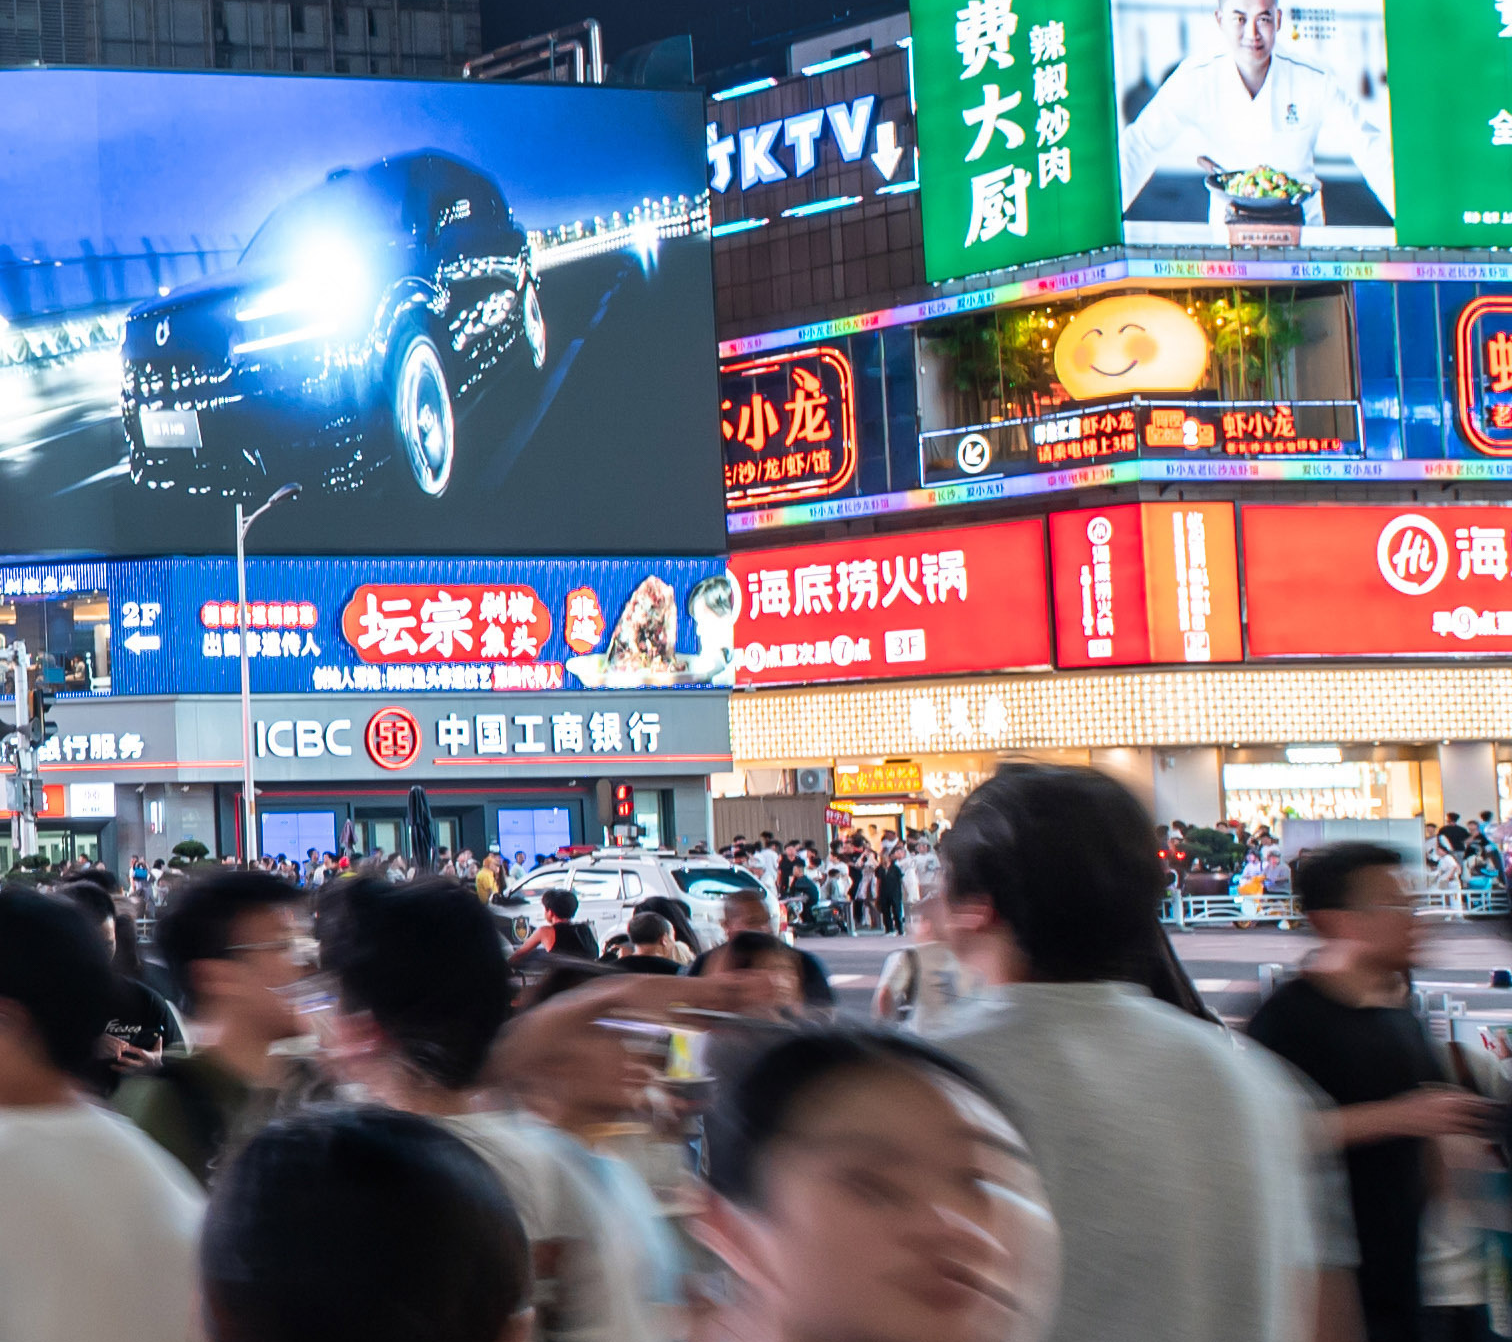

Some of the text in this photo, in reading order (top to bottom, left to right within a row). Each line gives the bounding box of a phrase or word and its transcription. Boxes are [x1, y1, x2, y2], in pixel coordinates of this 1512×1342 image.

[1029, 19, 1070, 189] 辣椒炒肉
[1222, 405, 1296, 437] 虾小龙
[1456, 526, 1512, 580] 海
[748, 550, 967, 620] 海底捞火锅
[122, 603, 161, 628] 2F
[357, 591, 474, 658] 坛宗
[255, 719, 352, 758] ICBC
[437, 711, 662, 755] 中国工商银行
